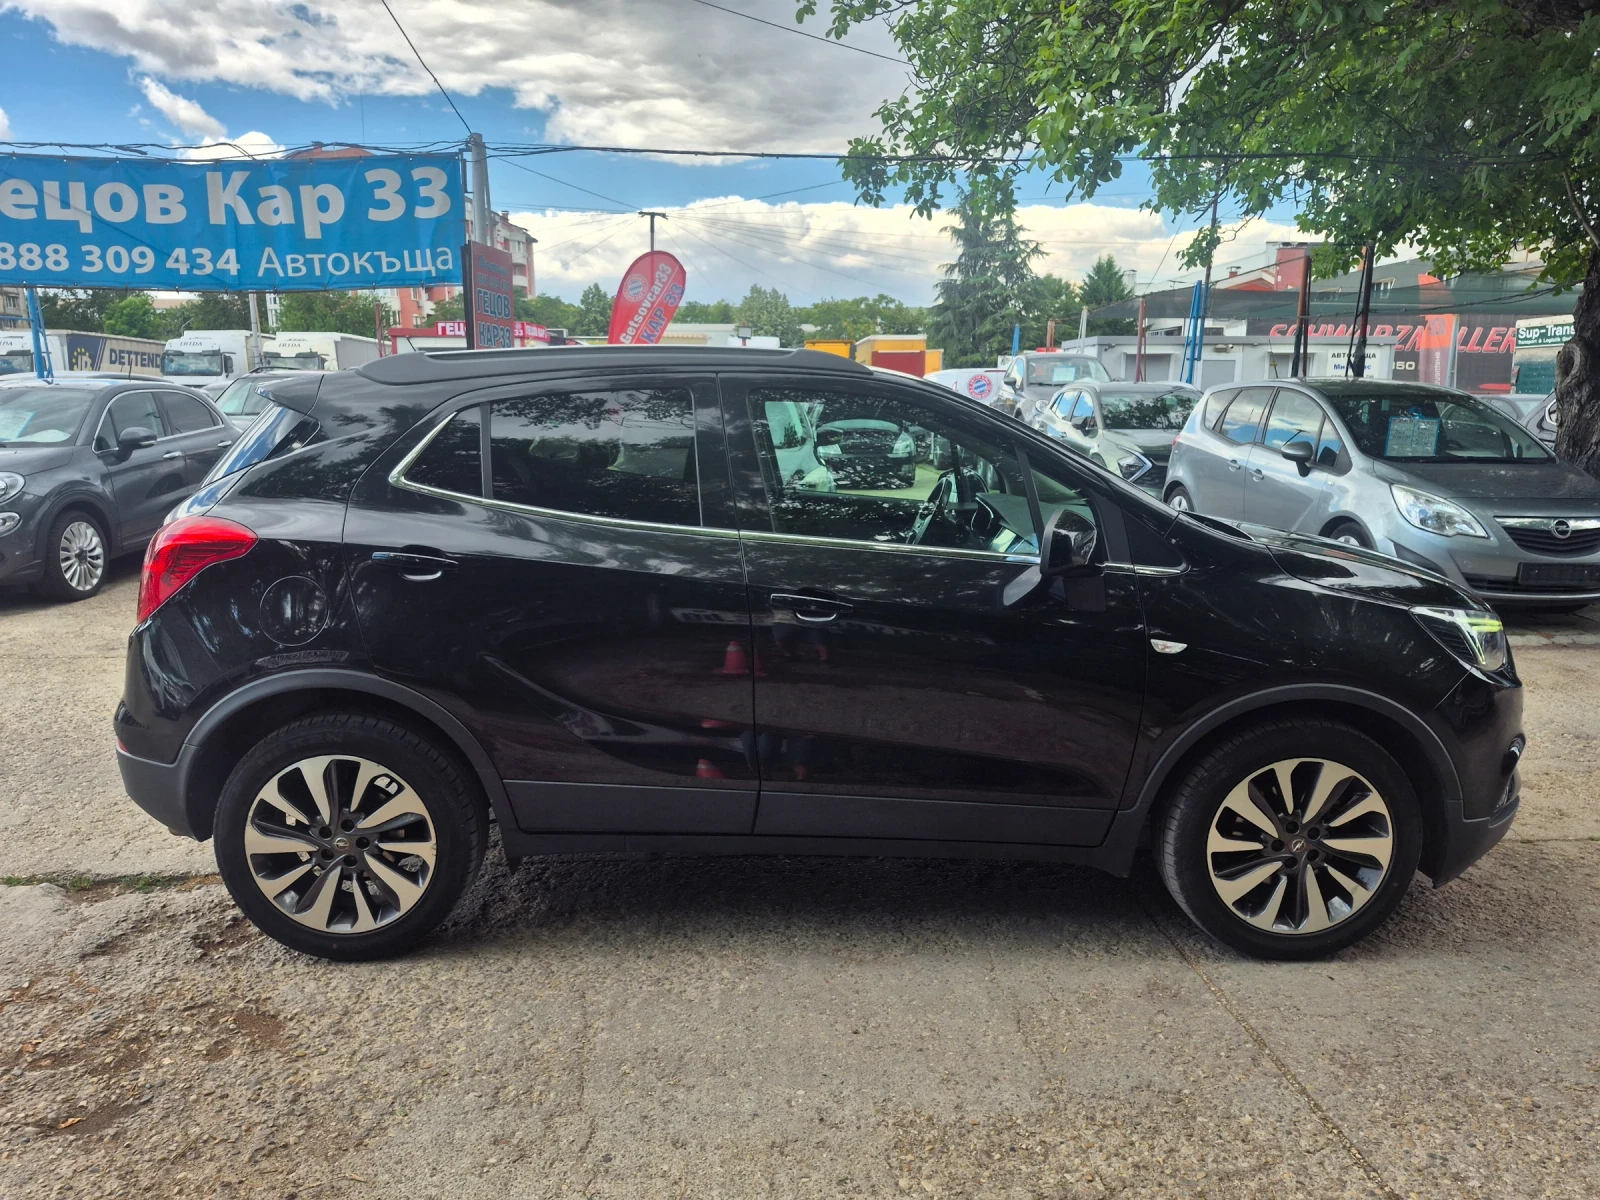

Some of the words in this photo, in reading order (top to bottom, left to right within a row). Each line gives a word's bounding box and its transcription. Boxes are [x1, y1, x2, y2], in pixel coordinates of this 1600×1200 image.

[206, 170, 346, 239] Кар
[364, 166, 452, 222] 33
[81, 244, 155, 274] 309
[165, 247, 241, 276] 434
[257, 246, 454, 277] Автокъща
[476, 288, 512, 320] ГЕЦОВ
[619, 263, 672, 344] Getsovcar33
[663, 283, 686, 306] 33
[437, 322, 467, 336] ГЕЦ
